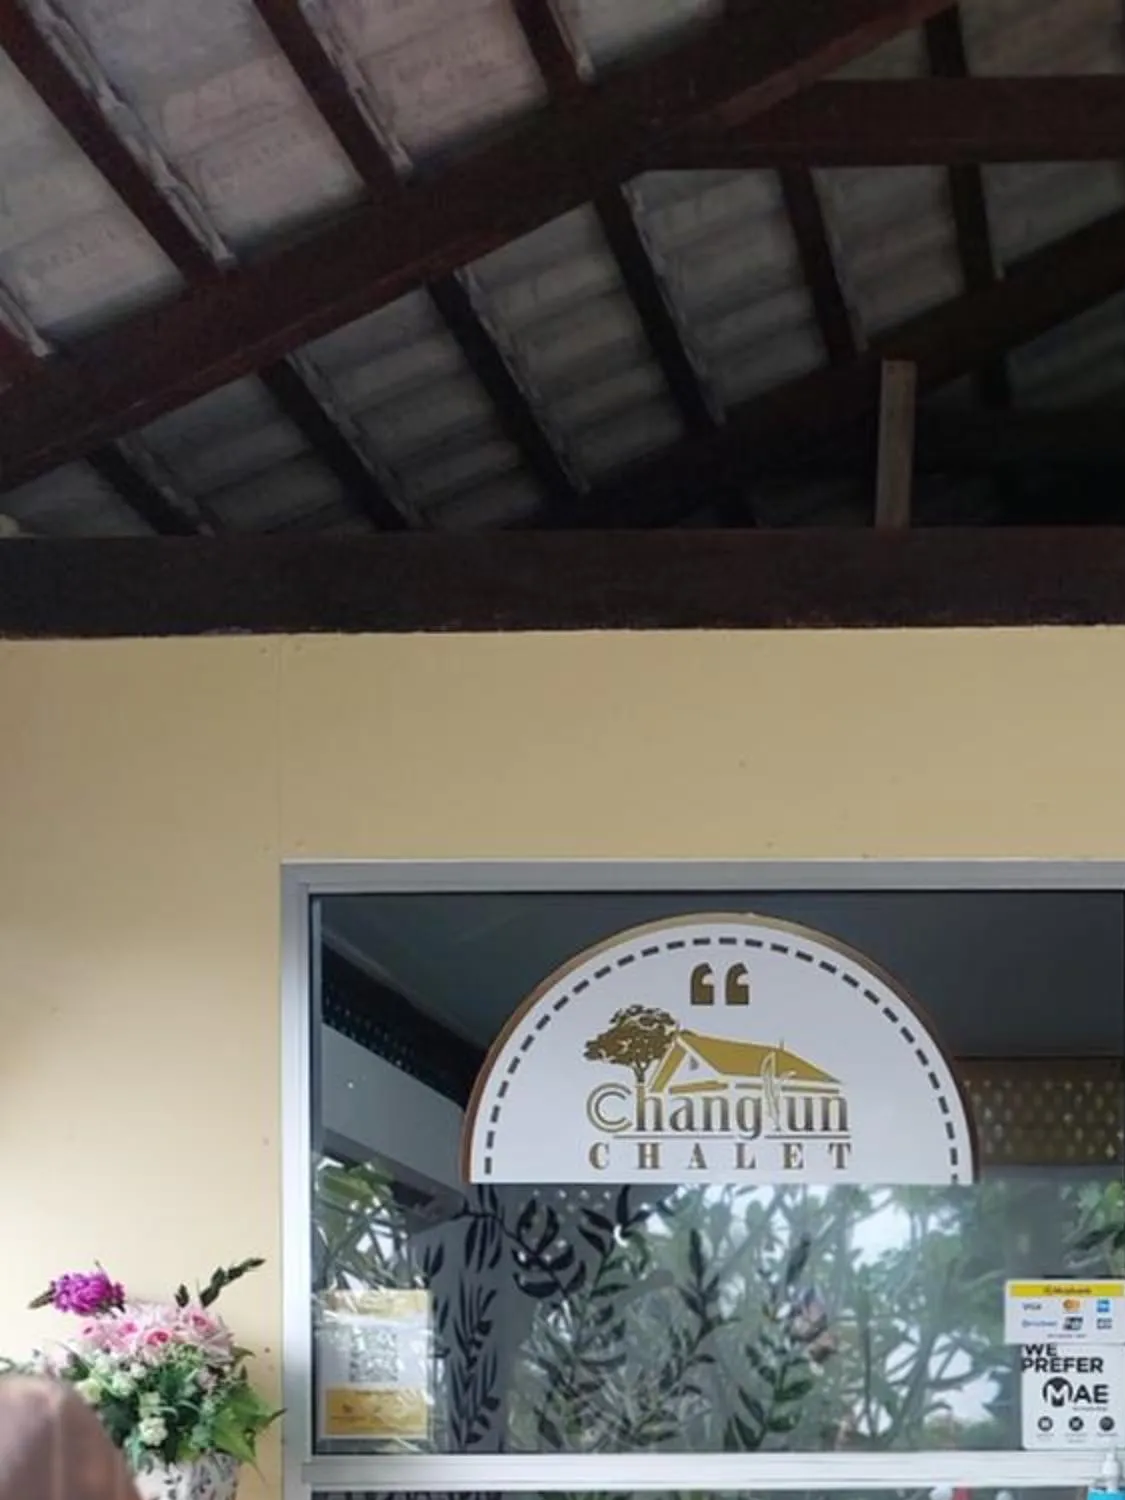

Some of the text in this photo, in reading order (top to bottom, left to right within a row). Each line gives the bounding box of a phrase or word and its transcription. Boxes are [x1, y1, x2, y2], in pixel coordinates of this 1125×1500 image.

[588, 1142, 852, 1170] CHALET
[1025, 1343, 1057, 1357] WE
[1021, 1357, 1103, 1373] PREFER
[1043, 1377, 1109, 1407] MAE
